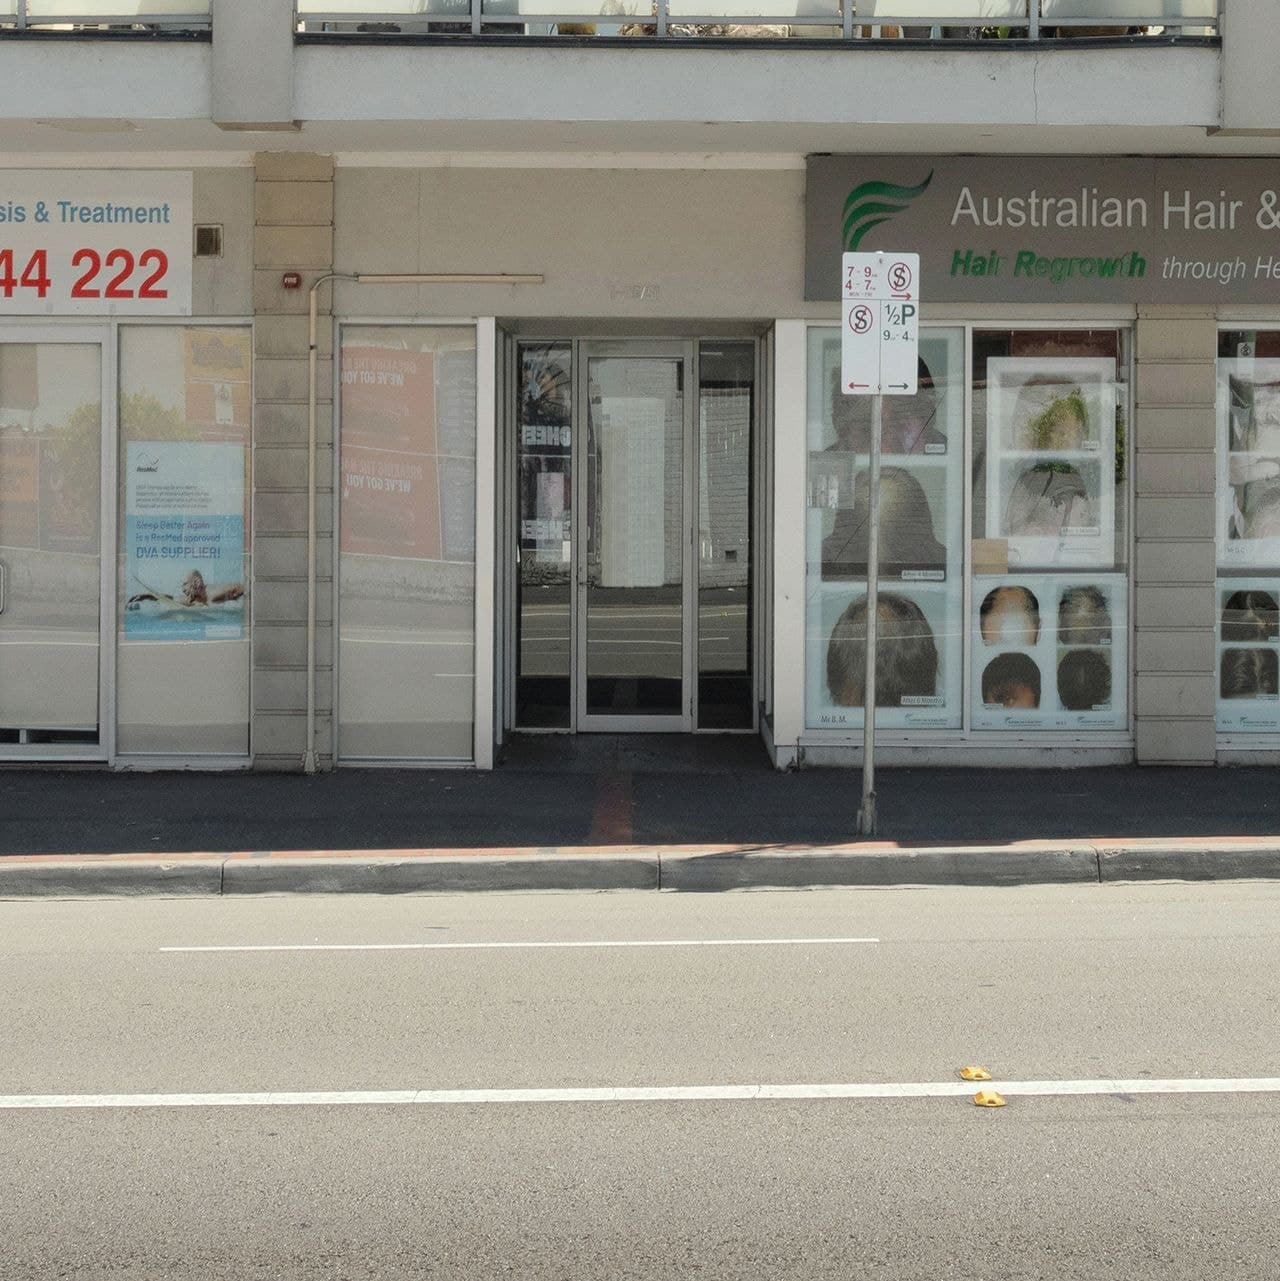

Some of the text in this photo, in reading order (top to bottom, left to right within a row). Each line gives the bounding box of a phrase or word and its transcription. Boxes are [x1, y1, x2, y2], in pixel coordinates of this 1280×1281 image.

[34, 200, 50, 223] &
[57, 200, 171, 224] Treatment
[950, 186, 1148, 228] Australian
[1162, 189, 1243, 230] Hair
[70, 248, 169, 299] 222
[950, 249, 1006, 278] Hair
[1014, 250, 1147, 285] Regrowth
[1162, 256, 1247, 285] through
[845, 279, 852, 291] 4
[136, 547, 221, 559] DVA SUPPLIER!
